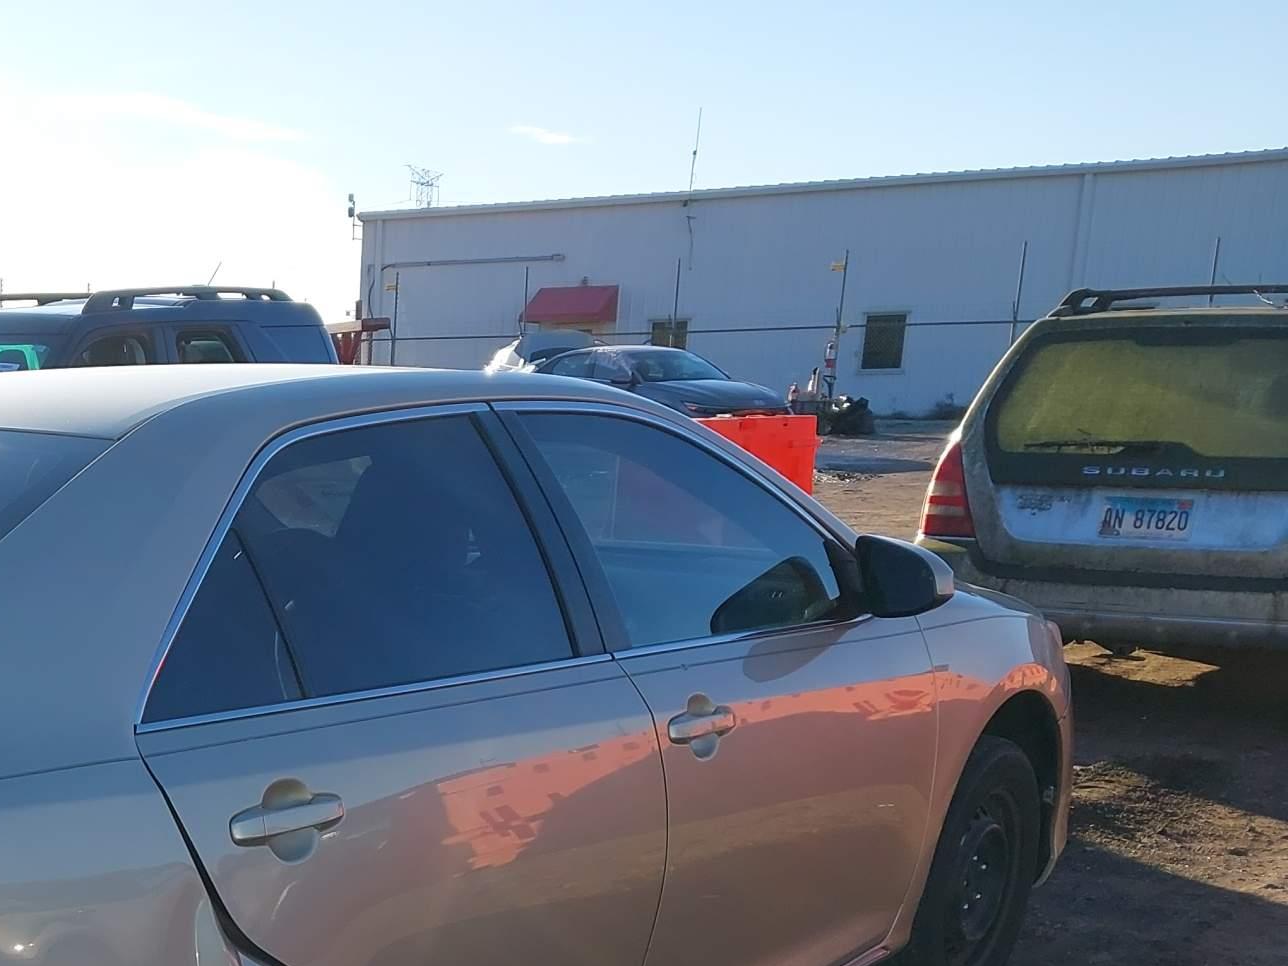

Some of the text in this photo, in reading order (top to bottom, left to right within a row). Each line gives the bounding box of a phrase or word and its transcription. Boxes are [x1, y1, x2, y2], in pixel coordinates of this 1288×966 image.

[1081, 465, 1225, 478] SUBARU
[1101, 507, 1190, 532] AN 87820
